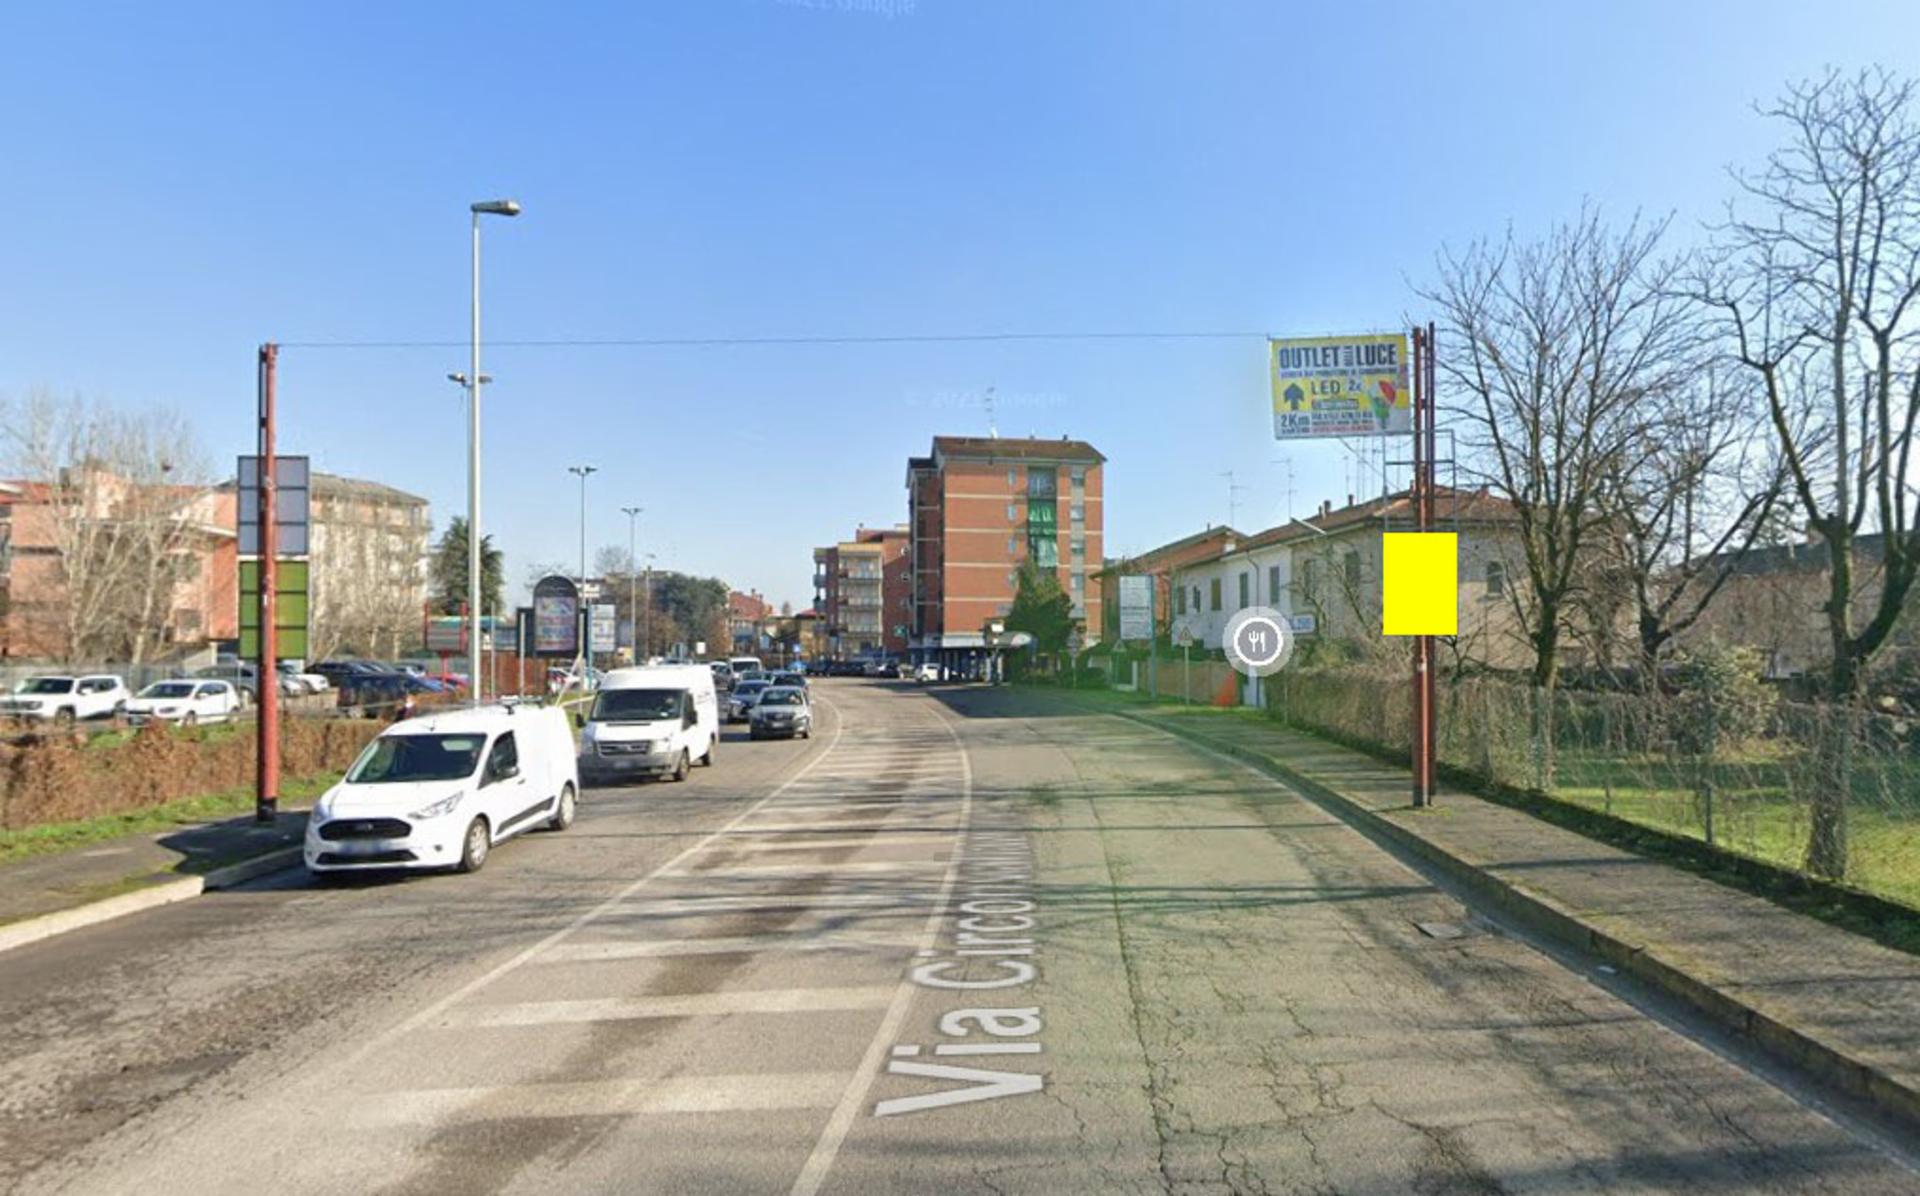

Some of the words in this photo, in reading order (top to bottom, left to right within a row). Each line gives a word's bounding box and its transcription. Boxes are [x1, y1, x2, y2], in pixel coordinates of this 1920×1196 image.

[1279, 346, 1340, 369] OUTLET
[1356, 343, 1397, 366] LUCE
[1310, 379, 1341, 396] LED
